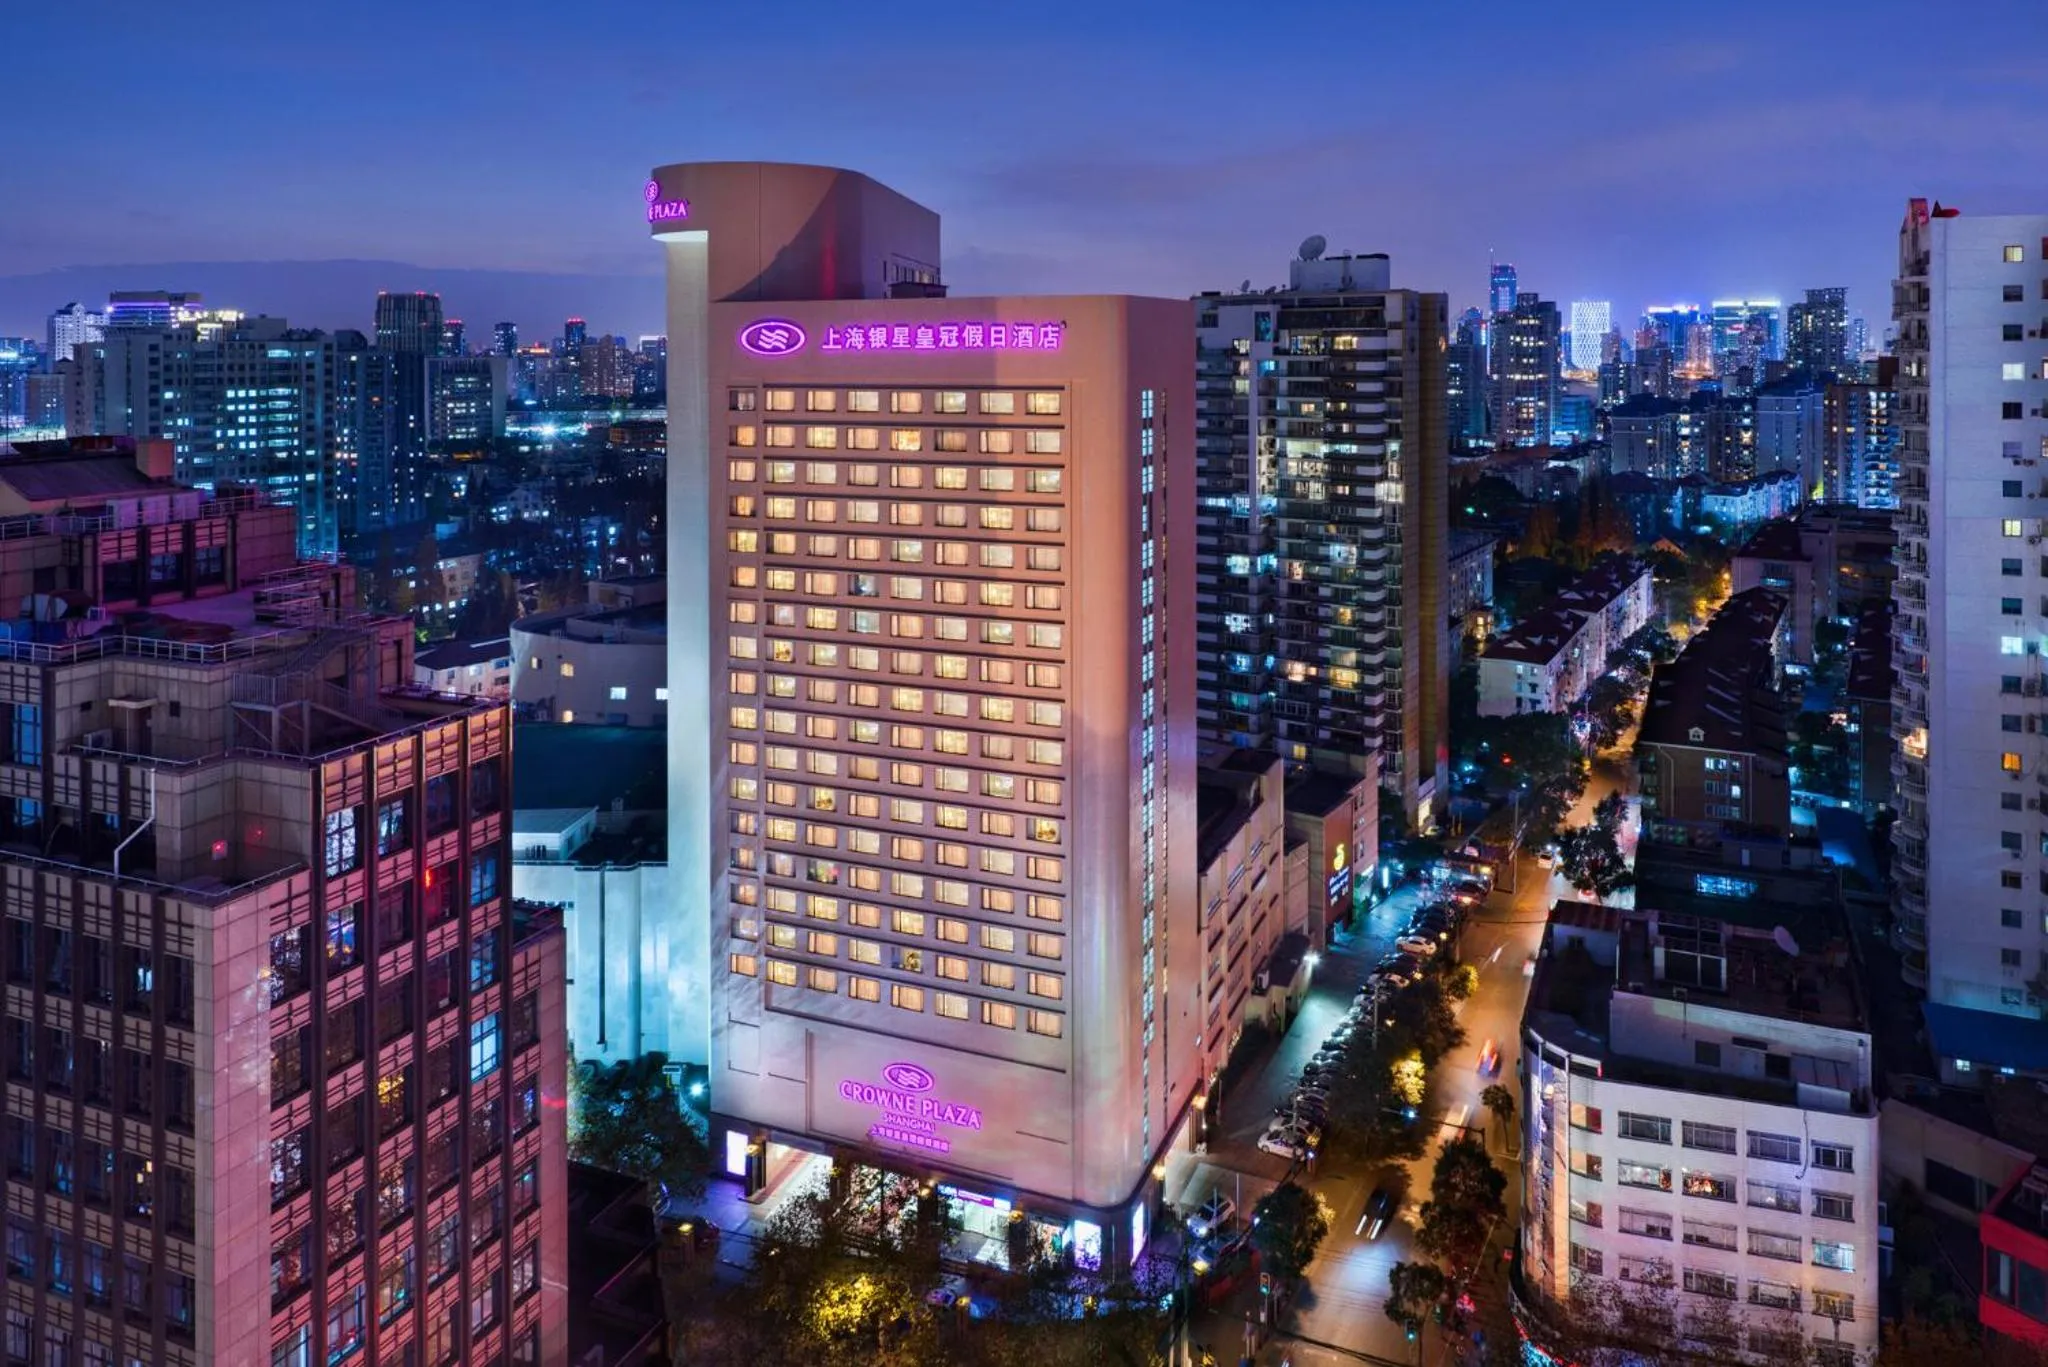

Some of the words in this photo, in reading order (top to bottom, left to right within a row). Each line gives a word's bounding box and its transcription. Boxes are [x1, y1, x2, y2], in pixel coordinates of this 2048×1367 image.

[654, 201, 687, 220] PLAZA
[822, 324, 1060, 350] 上海银星皇冠假日酒店
[840, 1081, 915, 1113] CROWNE
[921, 1099, 982, 1129] PLAZA
[883, 1112, 935, 1133] SHANGHAI
